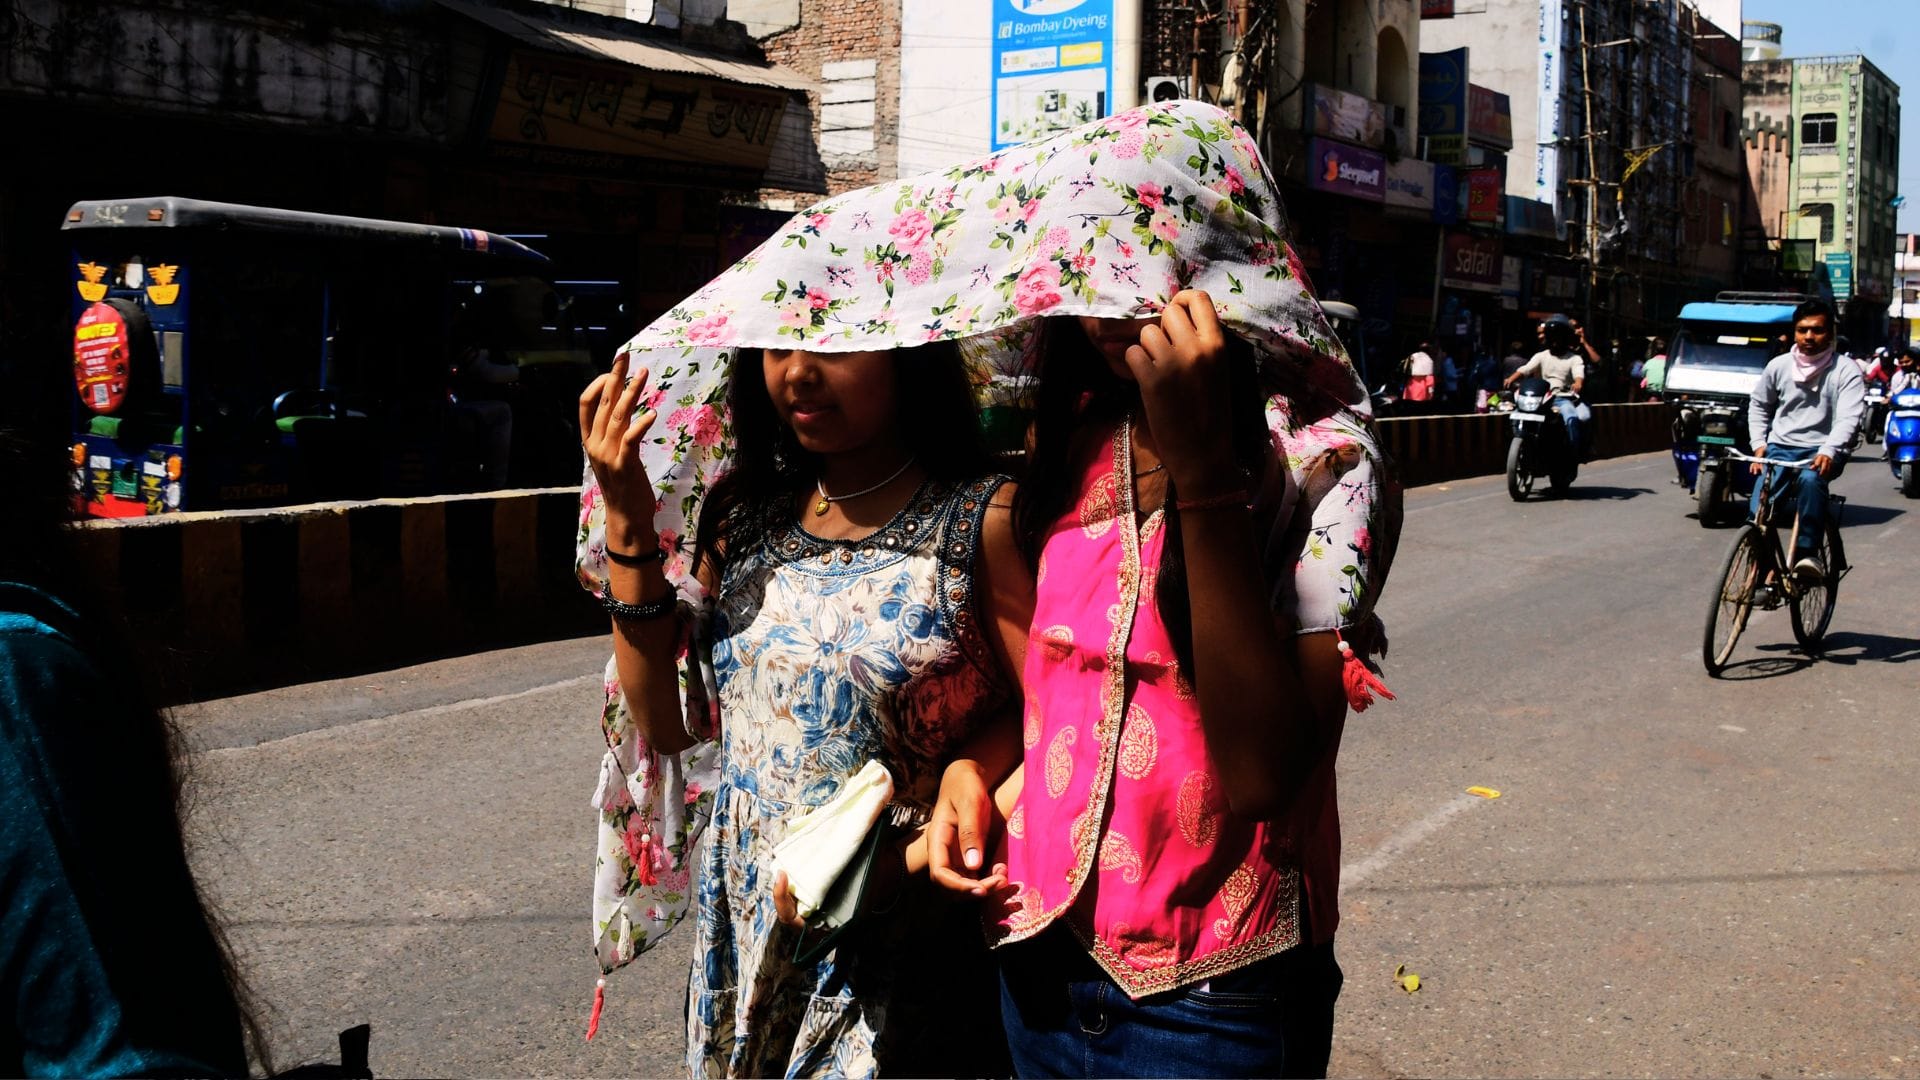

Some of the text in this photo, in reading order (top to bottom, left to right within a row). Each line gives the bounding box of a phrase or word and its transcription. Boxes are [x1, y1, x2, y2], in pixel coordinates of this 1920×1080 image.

[1015, 14, 1107, 34] Bombay Dyeing
[1455, 242, 1496, 276] safari
